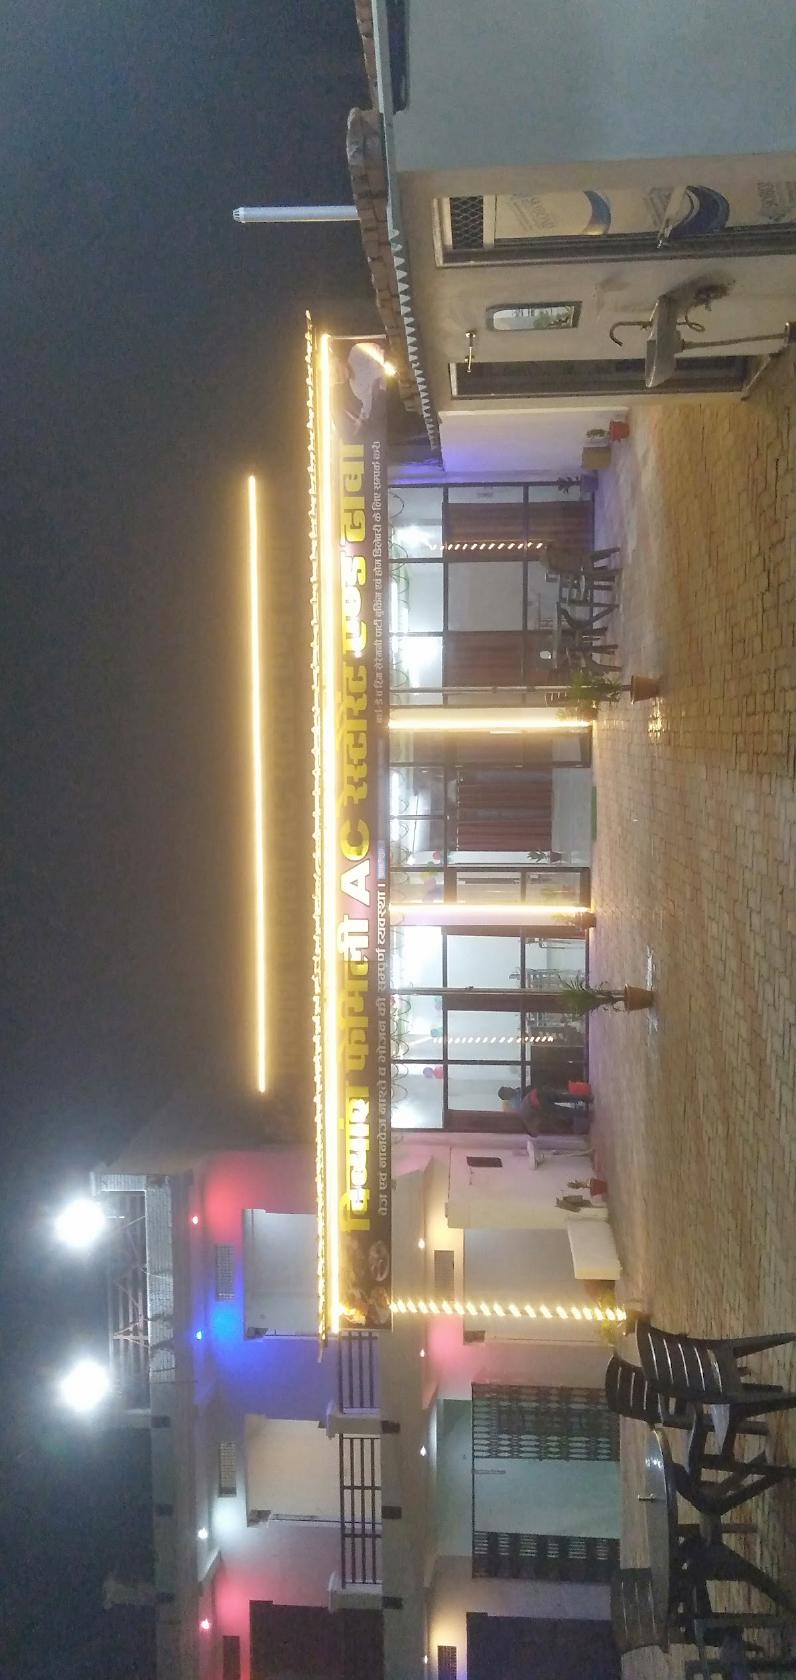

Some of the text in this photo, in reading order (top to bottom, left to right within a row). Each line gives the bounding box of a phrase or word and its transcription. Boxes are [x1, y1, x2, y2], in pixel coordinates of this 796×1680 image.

[340, 440, 366, 545] ढाबा
[372, 492, 382, 511] लिए
[372, 512, 382, 522] के
[373, 559, 383, 577] होम
[341, 819, 371, 907] AC
[377, 890, 387, 945] व्यवस्था
[376, 997, 387, 1017] की
[376, 1020, 387, 1063] भोजन
